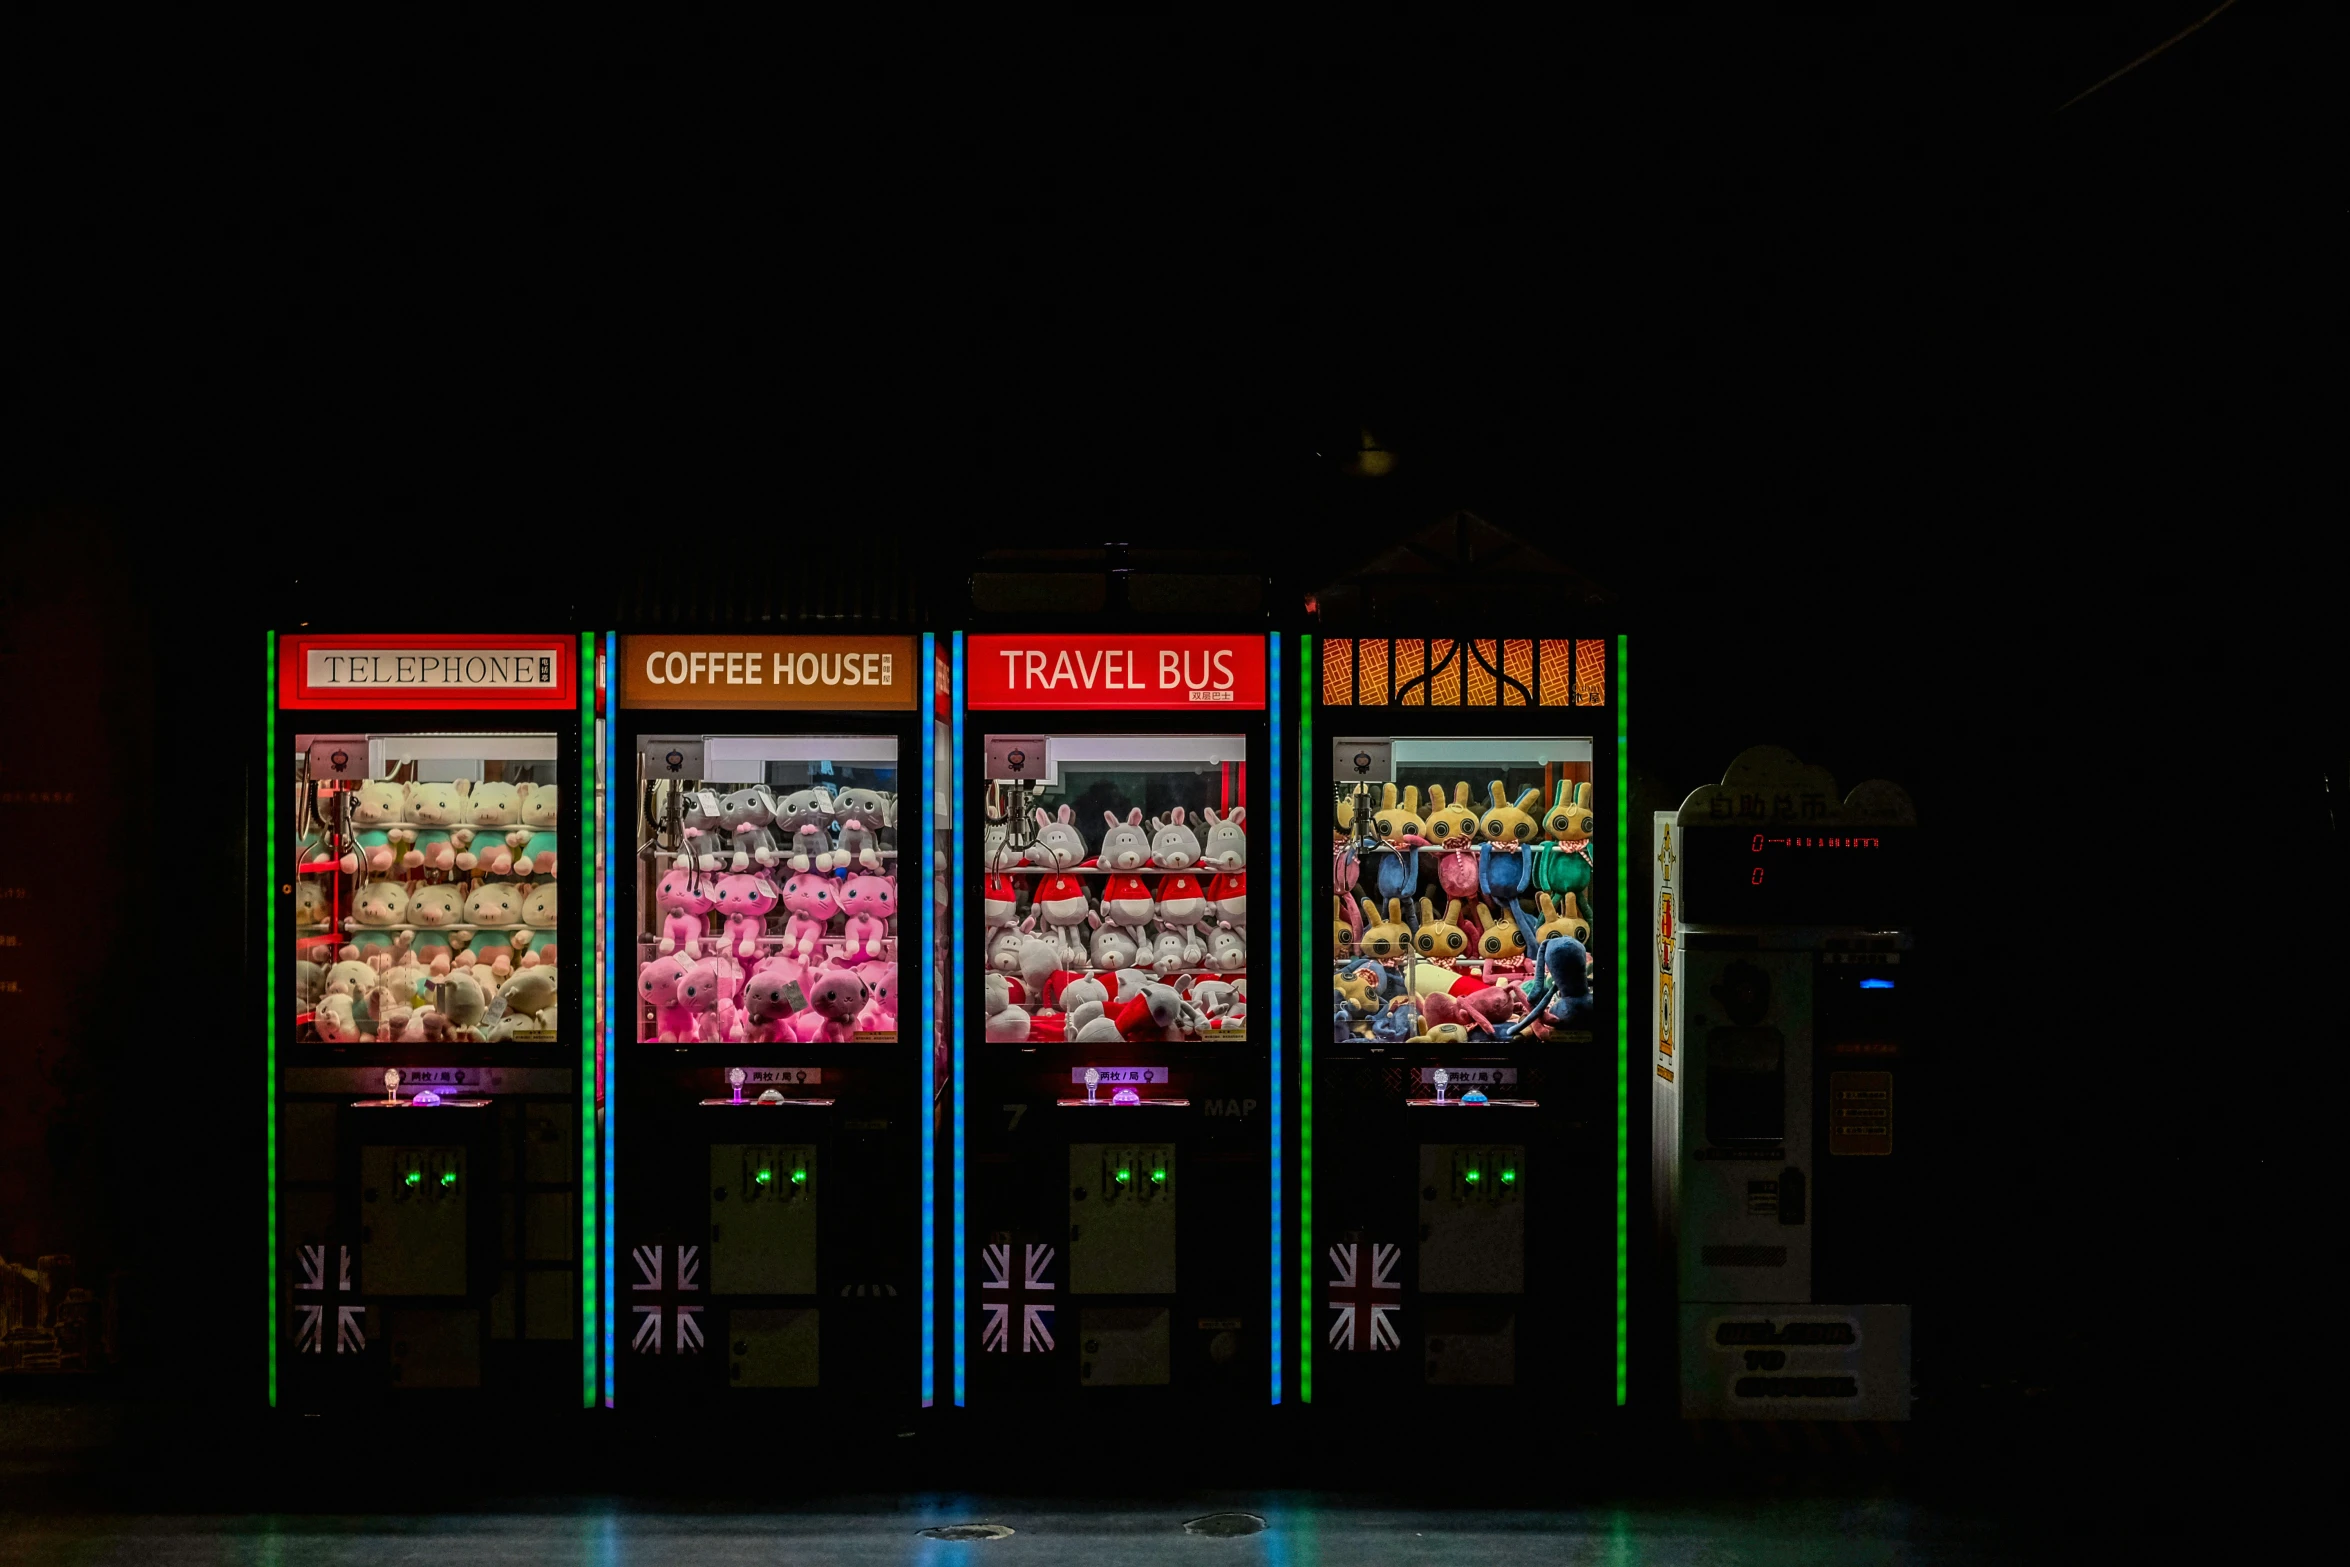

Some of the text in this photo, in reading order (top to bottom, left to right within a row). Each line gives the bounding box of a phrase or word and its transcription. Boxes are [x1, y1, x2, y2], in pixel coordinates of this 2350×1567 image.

[324, 656, 534, 683] TELEPHONE
[646, 651, 880, 686] COFFEE HOUSE
[1000, 649, 1234, 690] TRAVEL BUS
[1191, 690, 1232, 701] 双层巴士
[1003, 1103, 1028, 1132] 7
[1203, 1098, 1258, 1117] MAP
